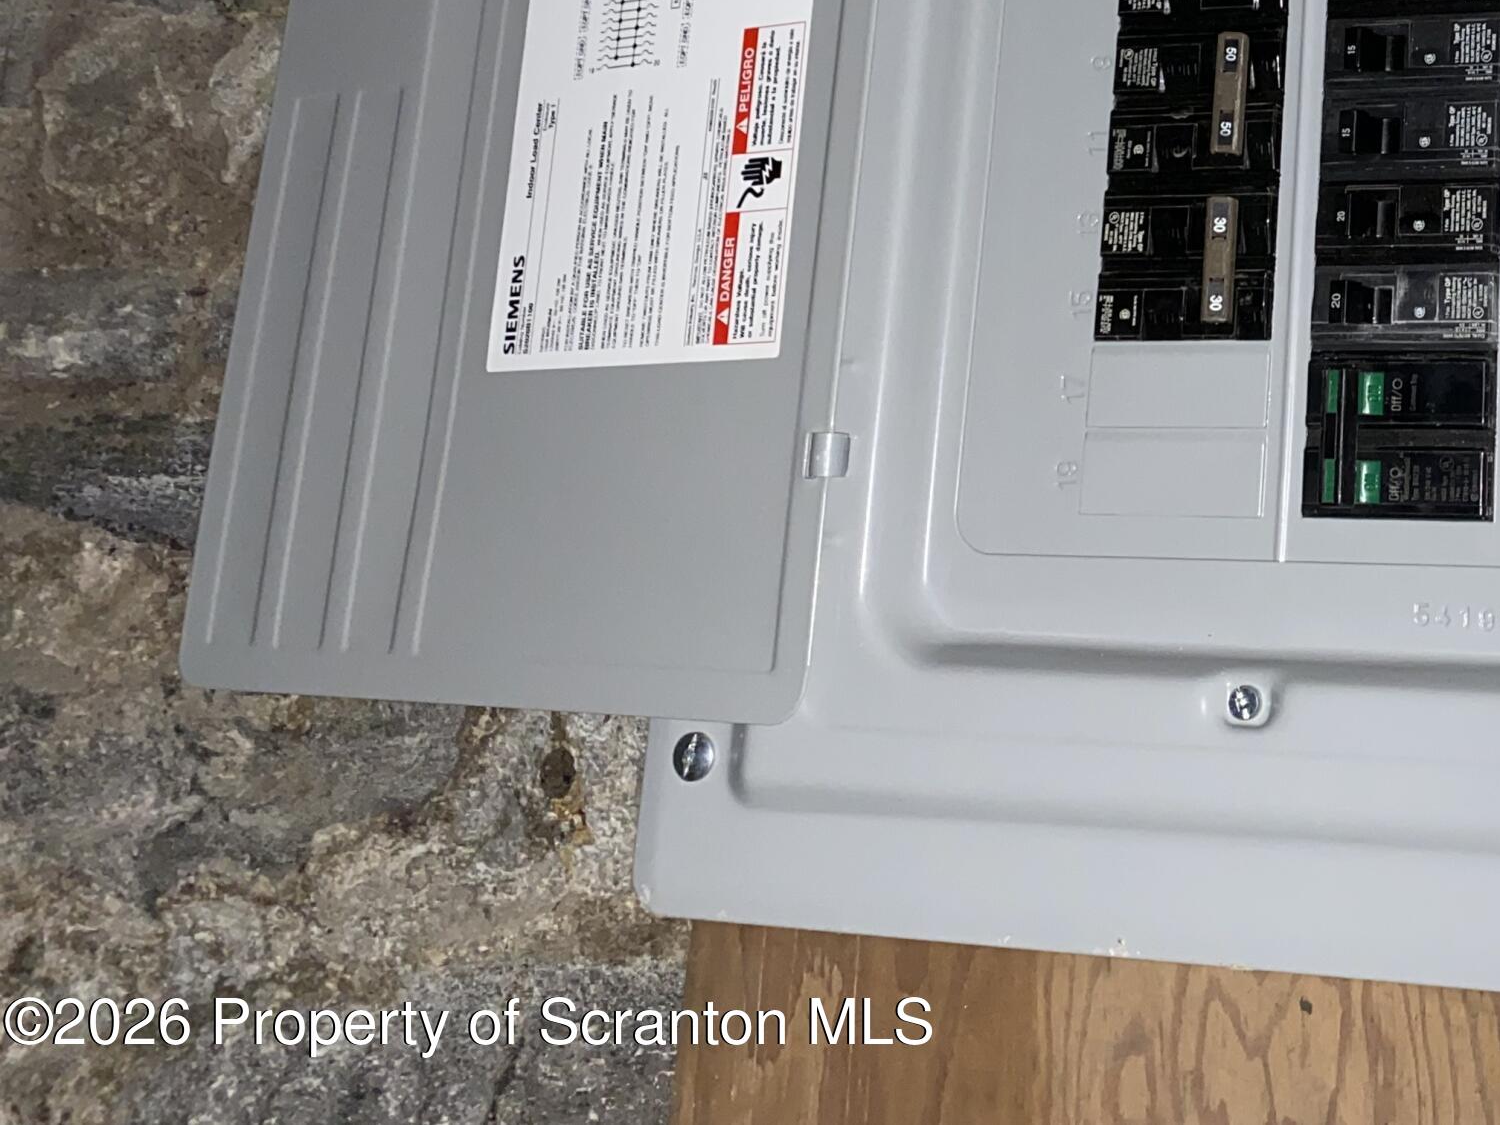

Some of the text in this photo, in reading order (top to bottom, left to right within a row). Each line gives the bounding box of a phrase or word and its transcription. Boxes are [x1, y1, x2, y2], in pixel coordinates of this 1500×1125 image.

[1224, 46, 1237, 62] 50
[1346, 44, 1356, 55] 15
[738, 46, 754, 112] PELIGRO
[548, 109, 557, 128] Type
[1219, 121, 1231, 137] 50
[600, 120, 608, 142] MAIN
[1341, 127, 1351, 138] 15
[525, 102, 543, 198] Indoor Load Center
[597, 144, 605, 168] WHEN
[592, 171, 602, 218] EQUIPMENT
[1212, 216, 1226, 233] 30
[1337, 211, 1347, 222] 20
[587, 221, 597, 256] SERVICE
[749, 222, 757, 243] injury
[586, 258, 593, 269] AS
[719, 236, 735, 301] DANGER
[752, 254, 760, 284] property
[502, 254, 525, 354] SIEMENS
[583, 251, 600, 350] BREAKER IS INSTALLED.
[748, 287, 756, 326] substantial
[1209, 294, 1223, 311] 30
[1331, 292, 1342, 309] 20
[577, 310, 587, 350] SUITABLE
[732, 300, 741, 338] Hazardous
[747, 330, 752, 338] or
